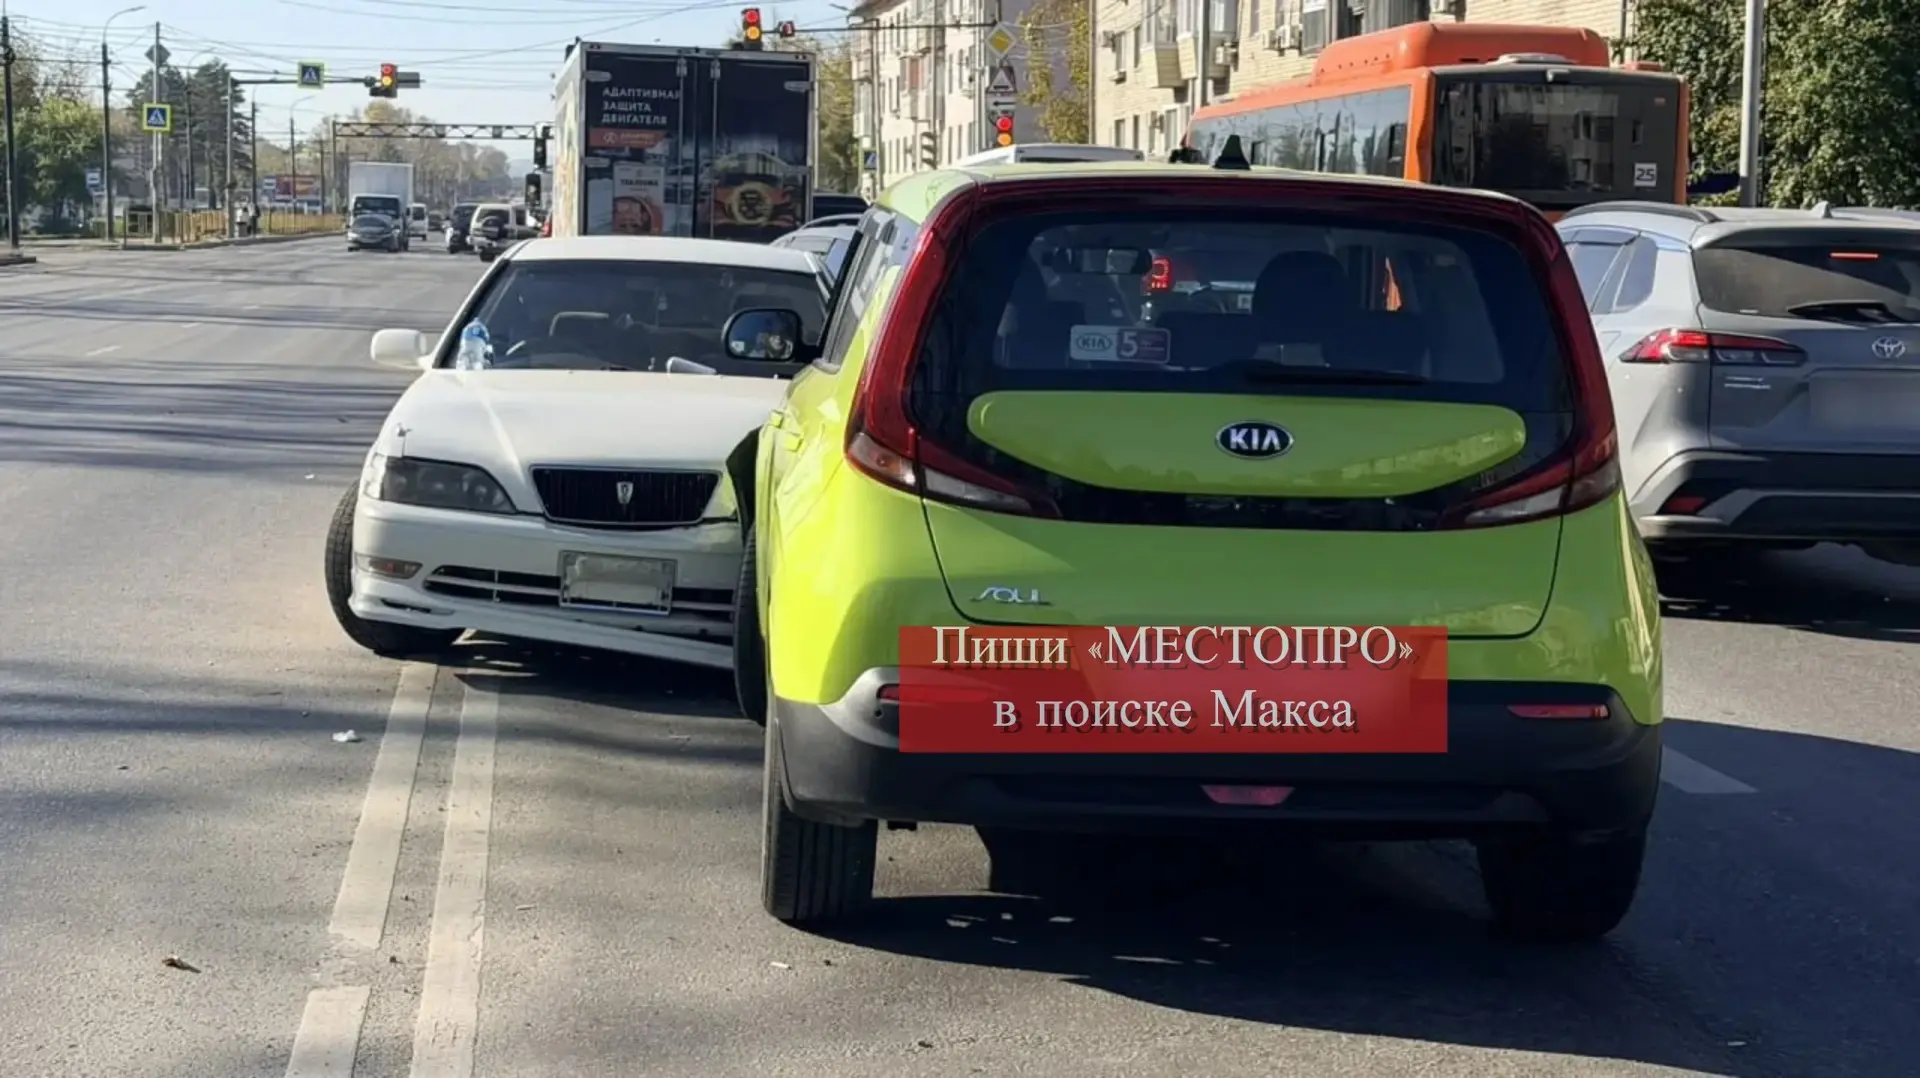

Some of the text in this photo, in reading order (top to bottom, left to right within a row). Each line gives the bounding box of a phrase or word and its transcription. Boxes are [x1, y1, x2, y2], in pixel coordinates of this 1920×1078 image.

[602, 100, 652, 112] ЗАЩИТА
[601, 113, 668, 125] ДВИГАТЕЛЯ
[1636, 167, 1655, 182] 25
[1079, 334, 1109, 350] KIA
[1120, 331, 1139, 358] 5
[1229, 427, 1282, 451] KIA
